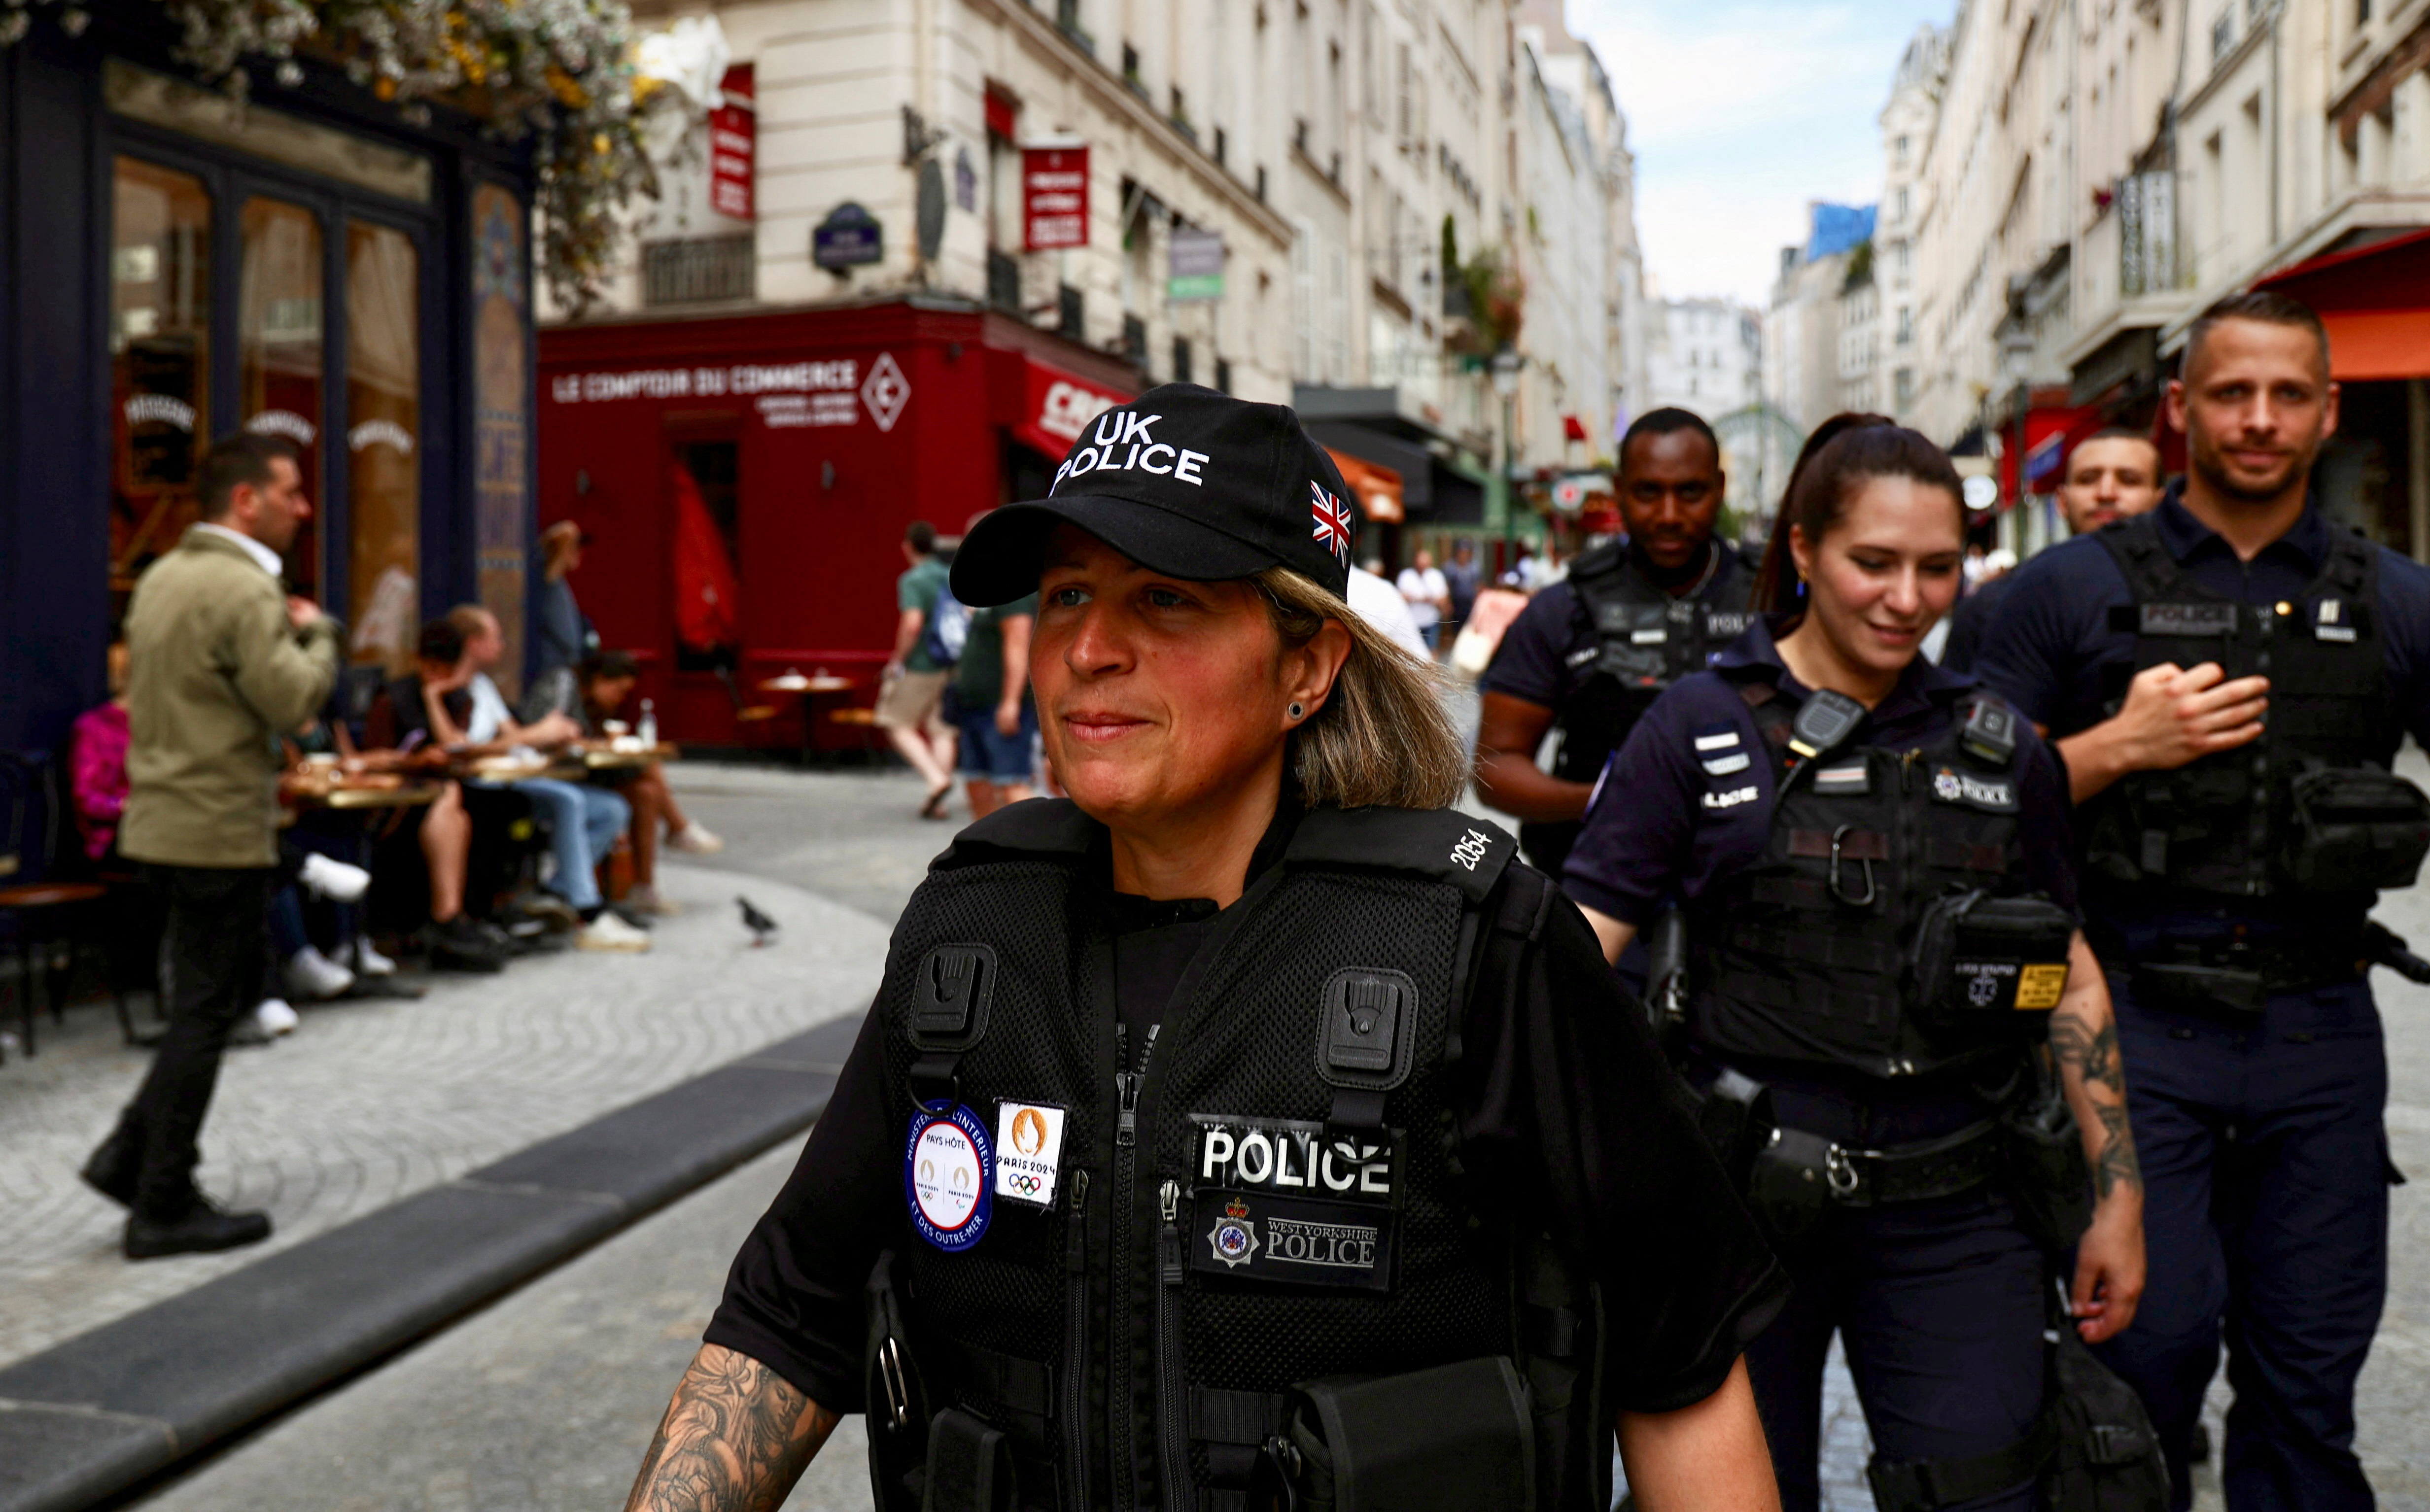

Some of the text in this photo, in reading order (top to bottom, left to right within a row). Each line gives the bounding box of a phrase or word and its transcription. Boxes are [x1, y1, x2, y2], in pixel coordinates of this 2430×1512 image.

[552, 359, 858, 403] LE COMPTOIR DU COMMERCE
[1094, 412, 1162, 446] UK
[1048, 443, 1210, 499] POLICE
[1450, 828, 1492, 871] 2054
[907, 1112, 933, 1161] MINISTER
[927, 1134, 965, 1150] PAYS HÔTE
[996, 1156, 1055, 1175] PARIS 2024
[1203, 1132, 1391, 1193] POLICE
[911, 1201, 983, 1244] ET DES OUTRE-MER
[1268, 1221, 1377, 1241] WEST YORKSHIRE
[1266, 1231, 1375, 1265] POLICE
